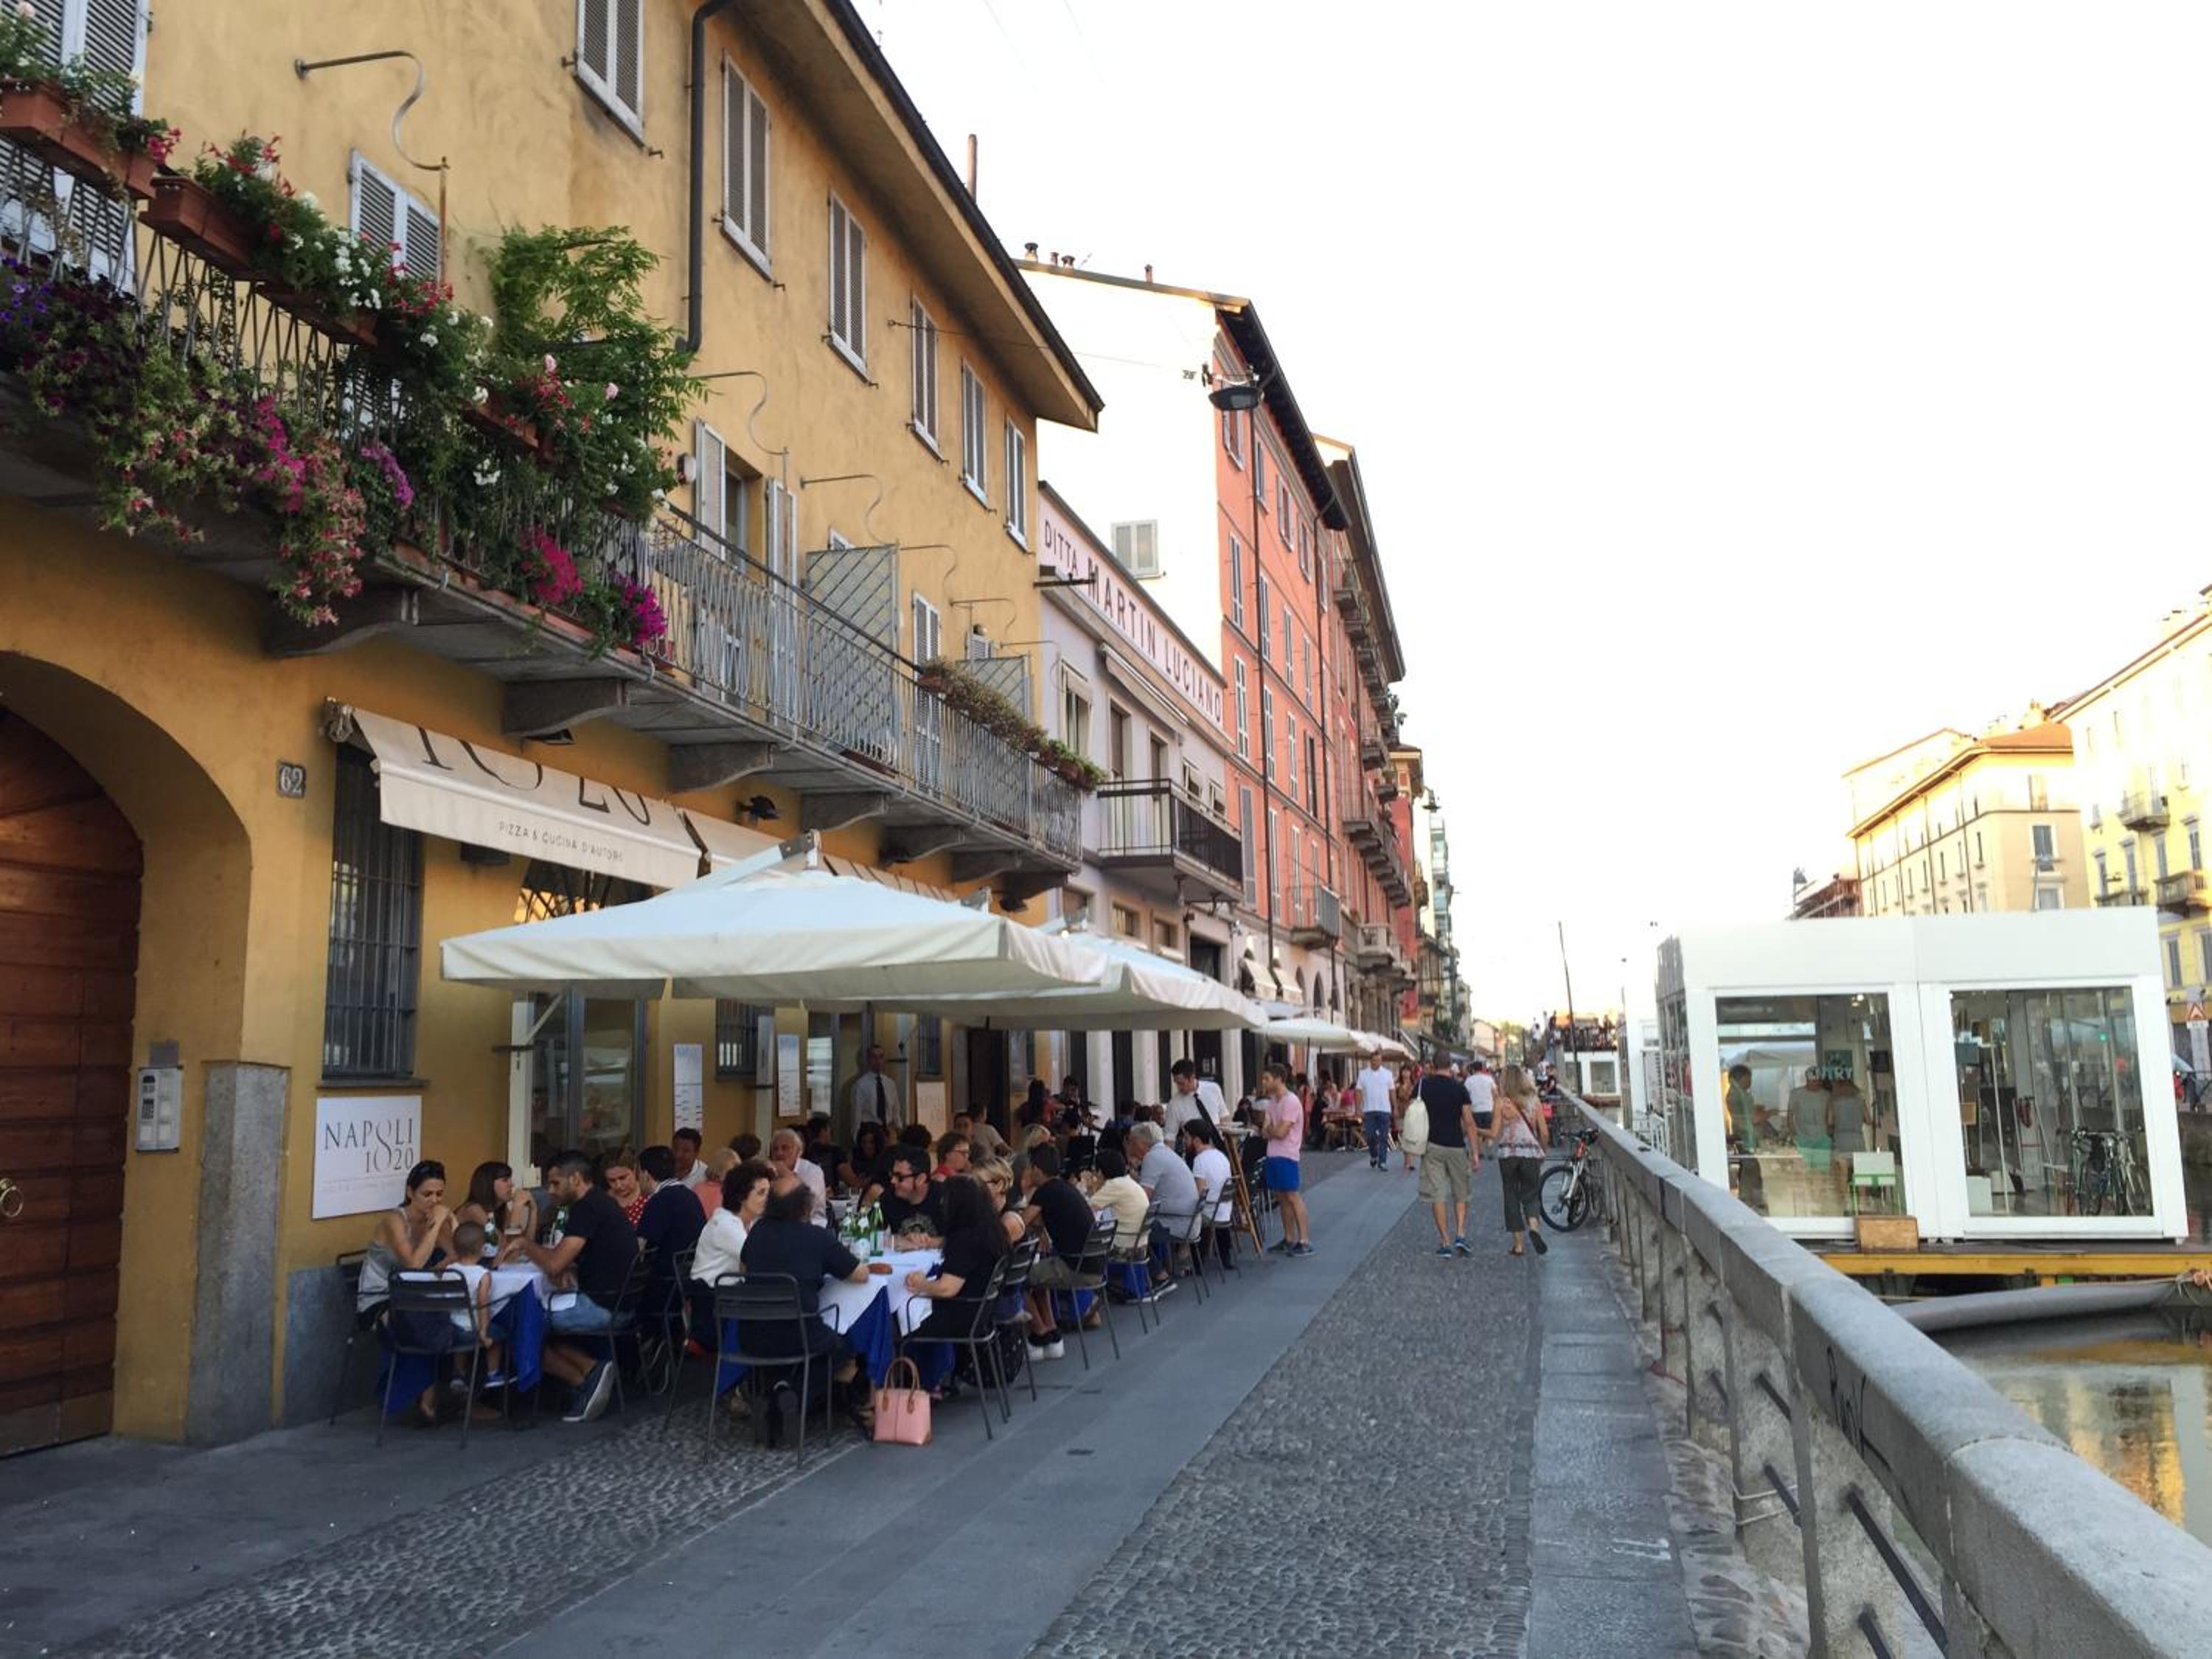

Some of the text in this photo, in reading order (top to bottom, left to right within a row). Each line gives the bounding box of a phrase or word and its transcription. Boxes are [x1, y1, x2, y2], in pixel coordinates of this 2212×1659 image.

[1045, 519, 1221, 723] DITTA MARTIN LUCIANO
[281, 766, 303, 795] 62
[498, 821, 529, 838] PIZZA
[541, 831, 578, 850] CUCINA
[324, 1117, 413, 1151] NAPOLI
